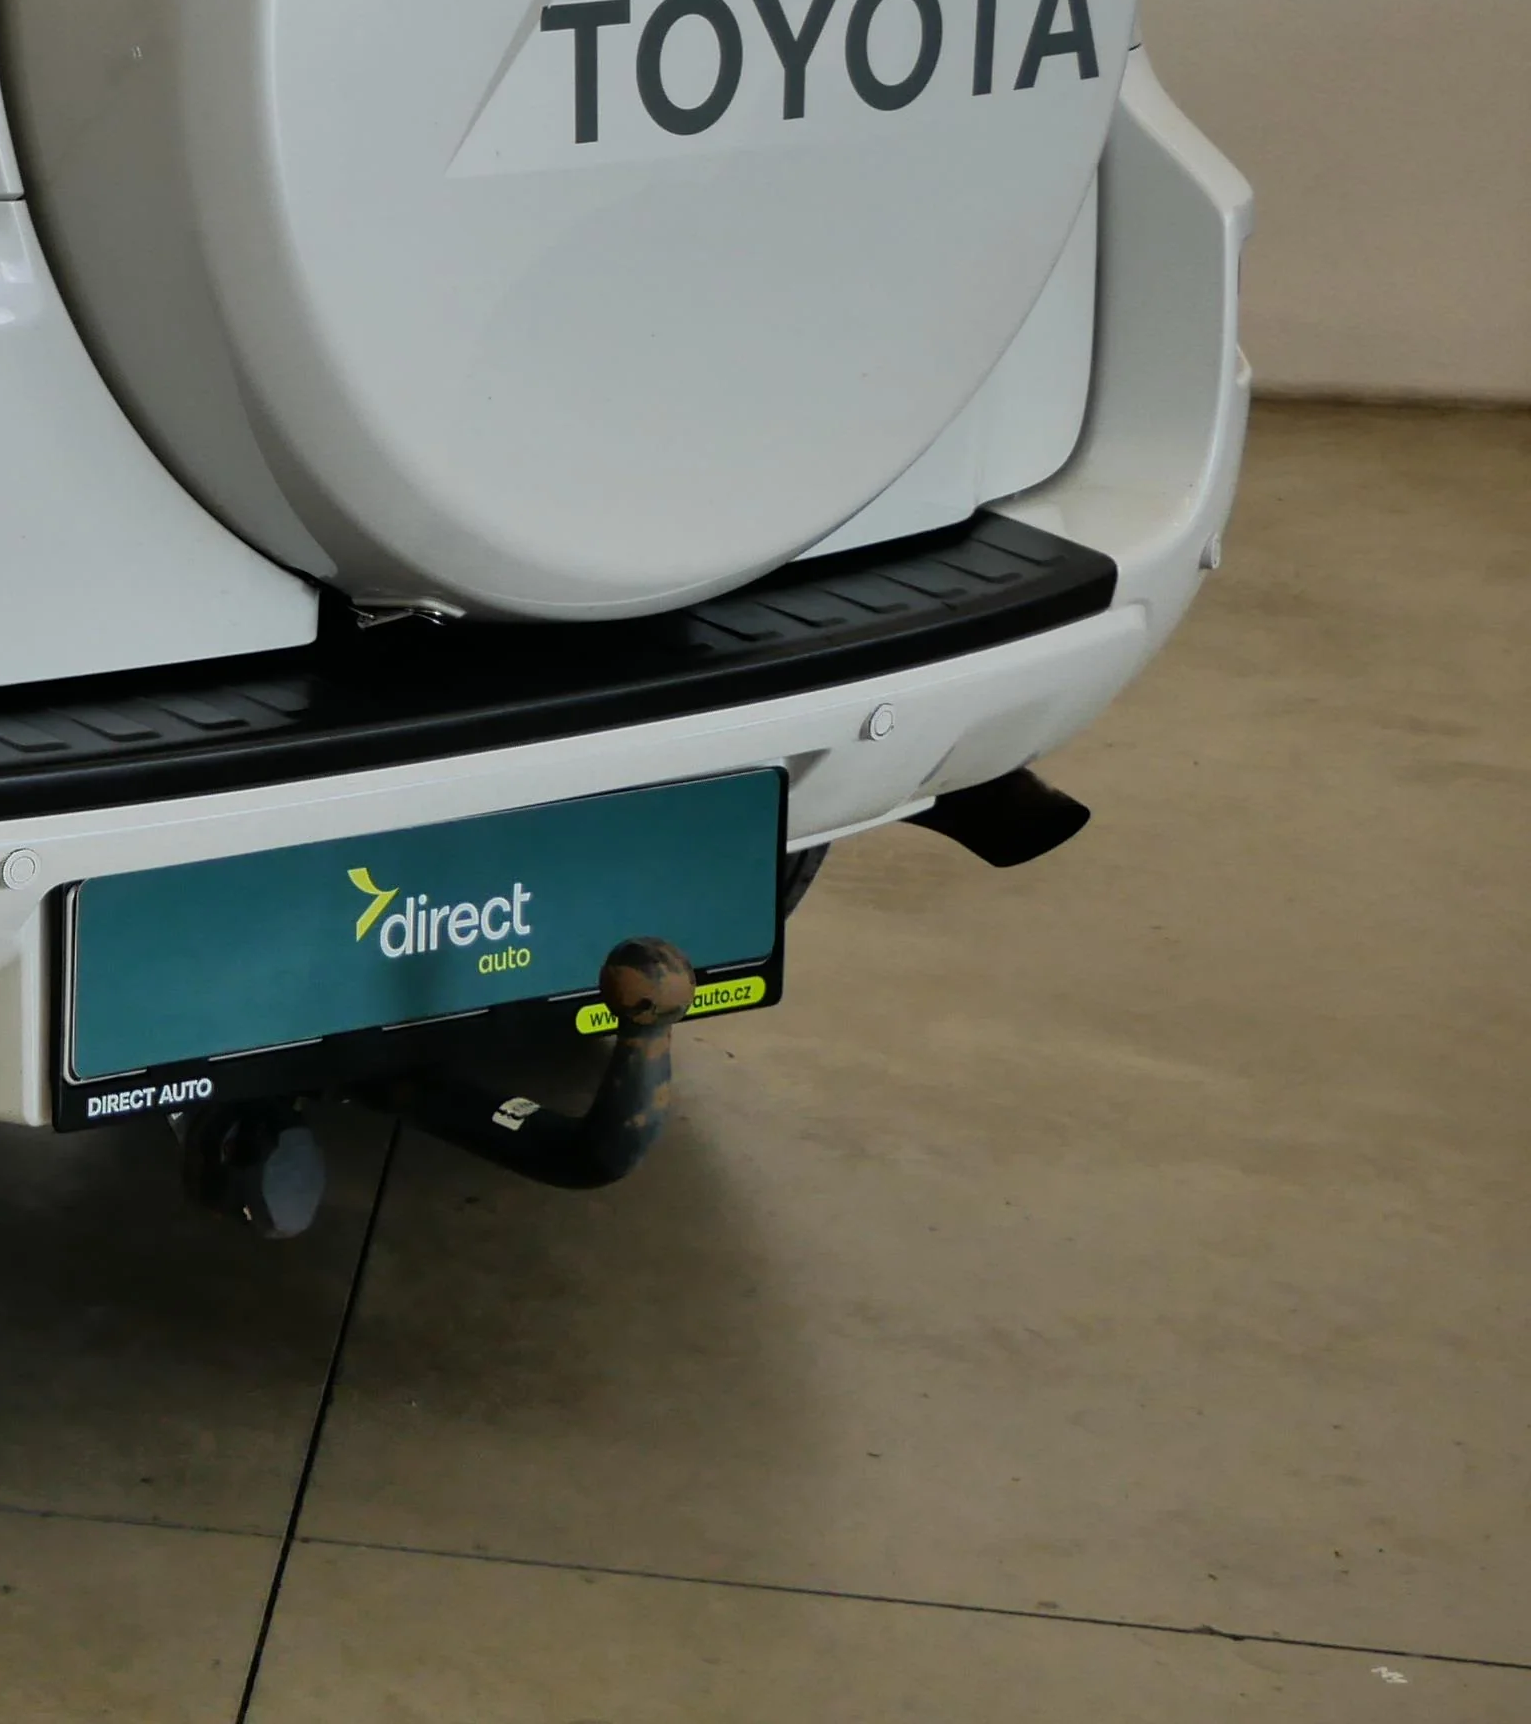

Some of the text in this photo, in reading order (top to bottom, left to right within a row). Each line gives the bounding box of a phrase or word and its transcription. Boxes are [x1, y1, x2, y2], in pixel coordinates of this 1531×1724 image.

[380, 882, 532, 958] direct
[478, 946, 531, 974] auto
[87, 1077, 213, 1117] DIRECT AUTO
